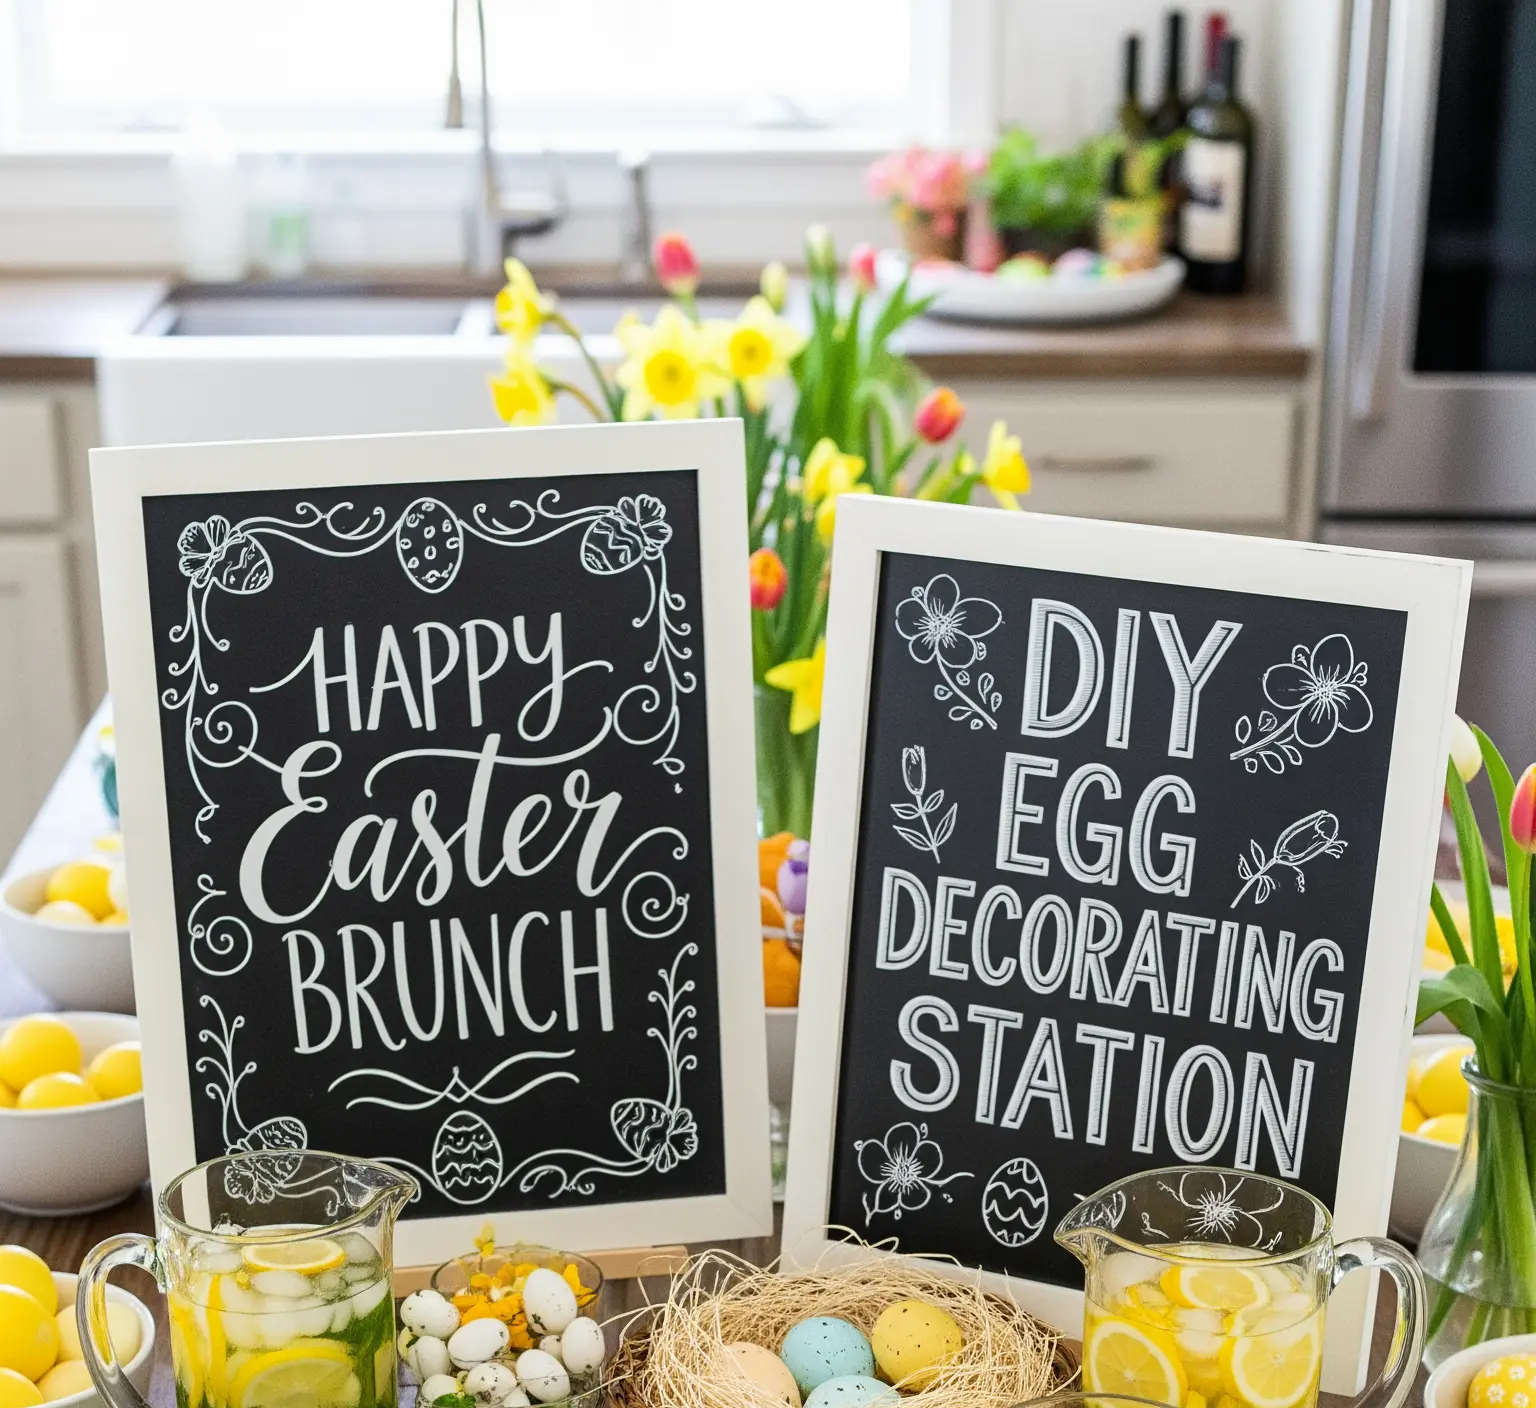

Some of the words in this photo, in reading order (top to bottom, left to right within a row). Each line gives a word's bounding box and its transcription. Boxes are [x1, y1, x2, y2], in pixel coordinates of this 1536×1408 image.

[248, 611, 614, 742] HAPPY
[1020, 597, 1244, 760] DIY
[237, 707, 690, 925] Easter
[995, 751, 1197, 898] EGG
[281, 907, 615, 1055] BRUNCH
[875, 866, 1345, 1044] DECORATING
[889, 994, 1316, 1180] STATION
